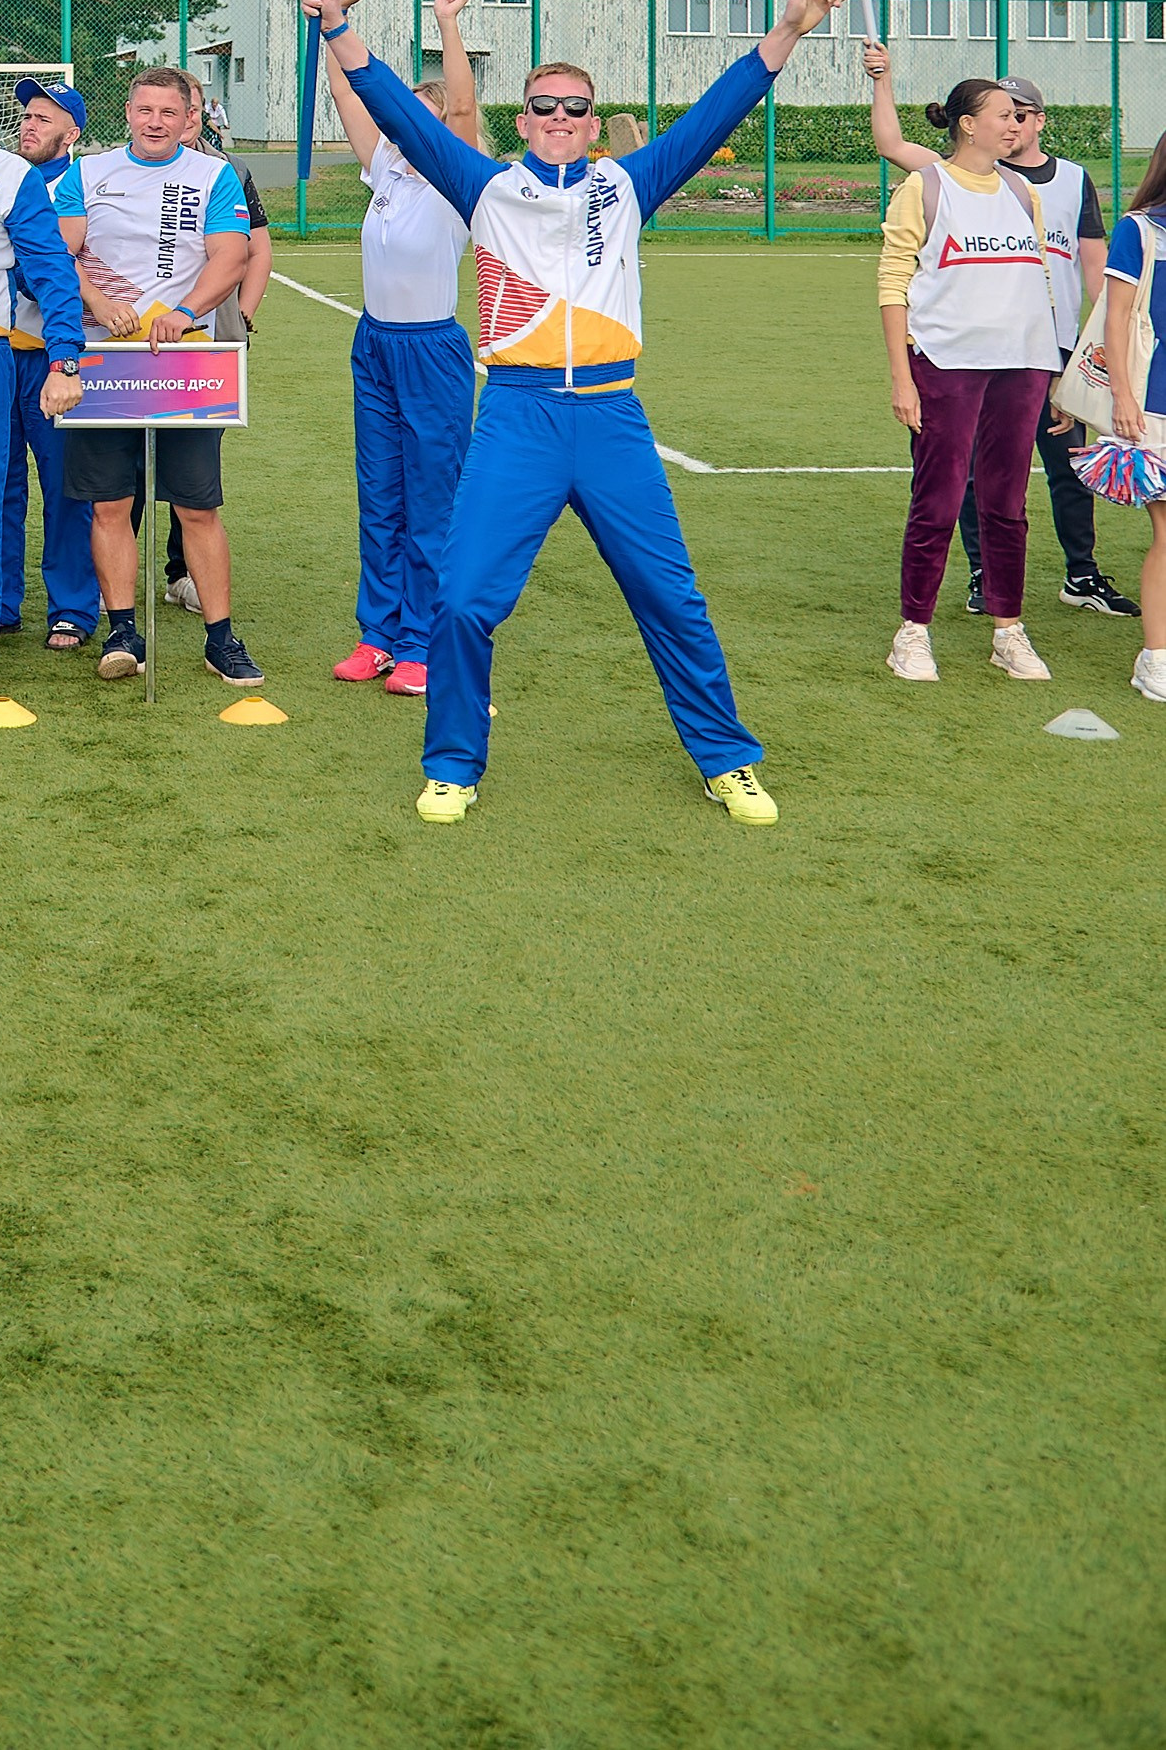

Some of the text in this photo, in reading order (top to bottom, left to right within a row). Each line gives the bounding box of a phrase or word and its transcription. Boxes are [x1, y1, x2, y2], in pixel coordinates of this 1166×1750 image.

[157, 182, 180, 279] БАЛАХТИНСКОЕ
[179, 185, 201, 232] ДРСУ
[187, 379, 225, 393] ДРСУ
